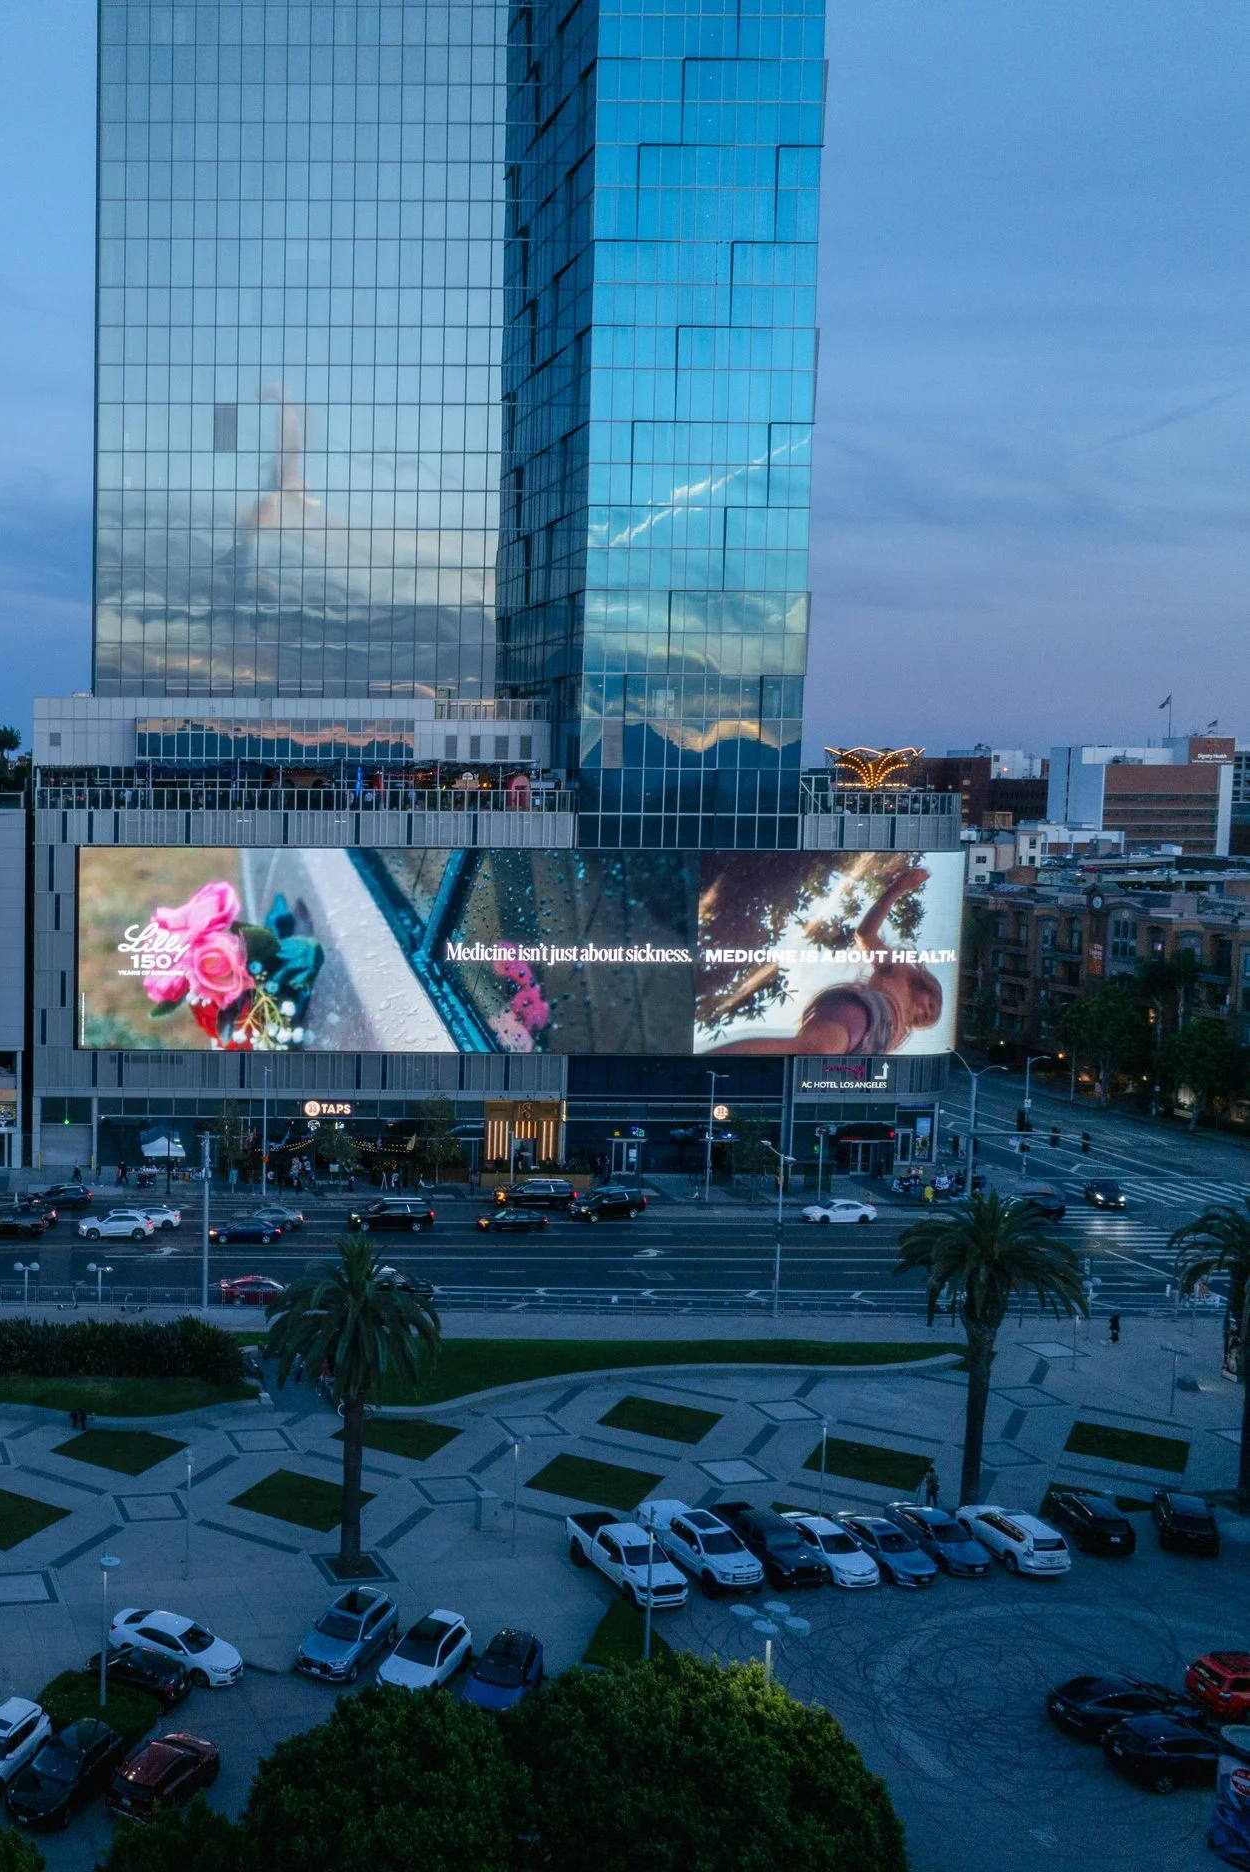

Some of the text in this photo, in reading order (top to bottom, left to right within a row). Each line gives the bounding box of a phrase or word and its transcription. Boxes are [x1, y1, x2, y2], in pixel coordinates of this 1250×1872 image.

[117, 921, 190, 963] Lilly
[130, 954, 172, 969] 150
[446, 942, 693, 966] Medicine isn't just about sickness.
[705, 949, 798, 963] MEDICINE
[800, 950, 818, 963] IS
[820, 950, 888, 964] ABOUT
[321, 1103, 351, 1115] TAPS
